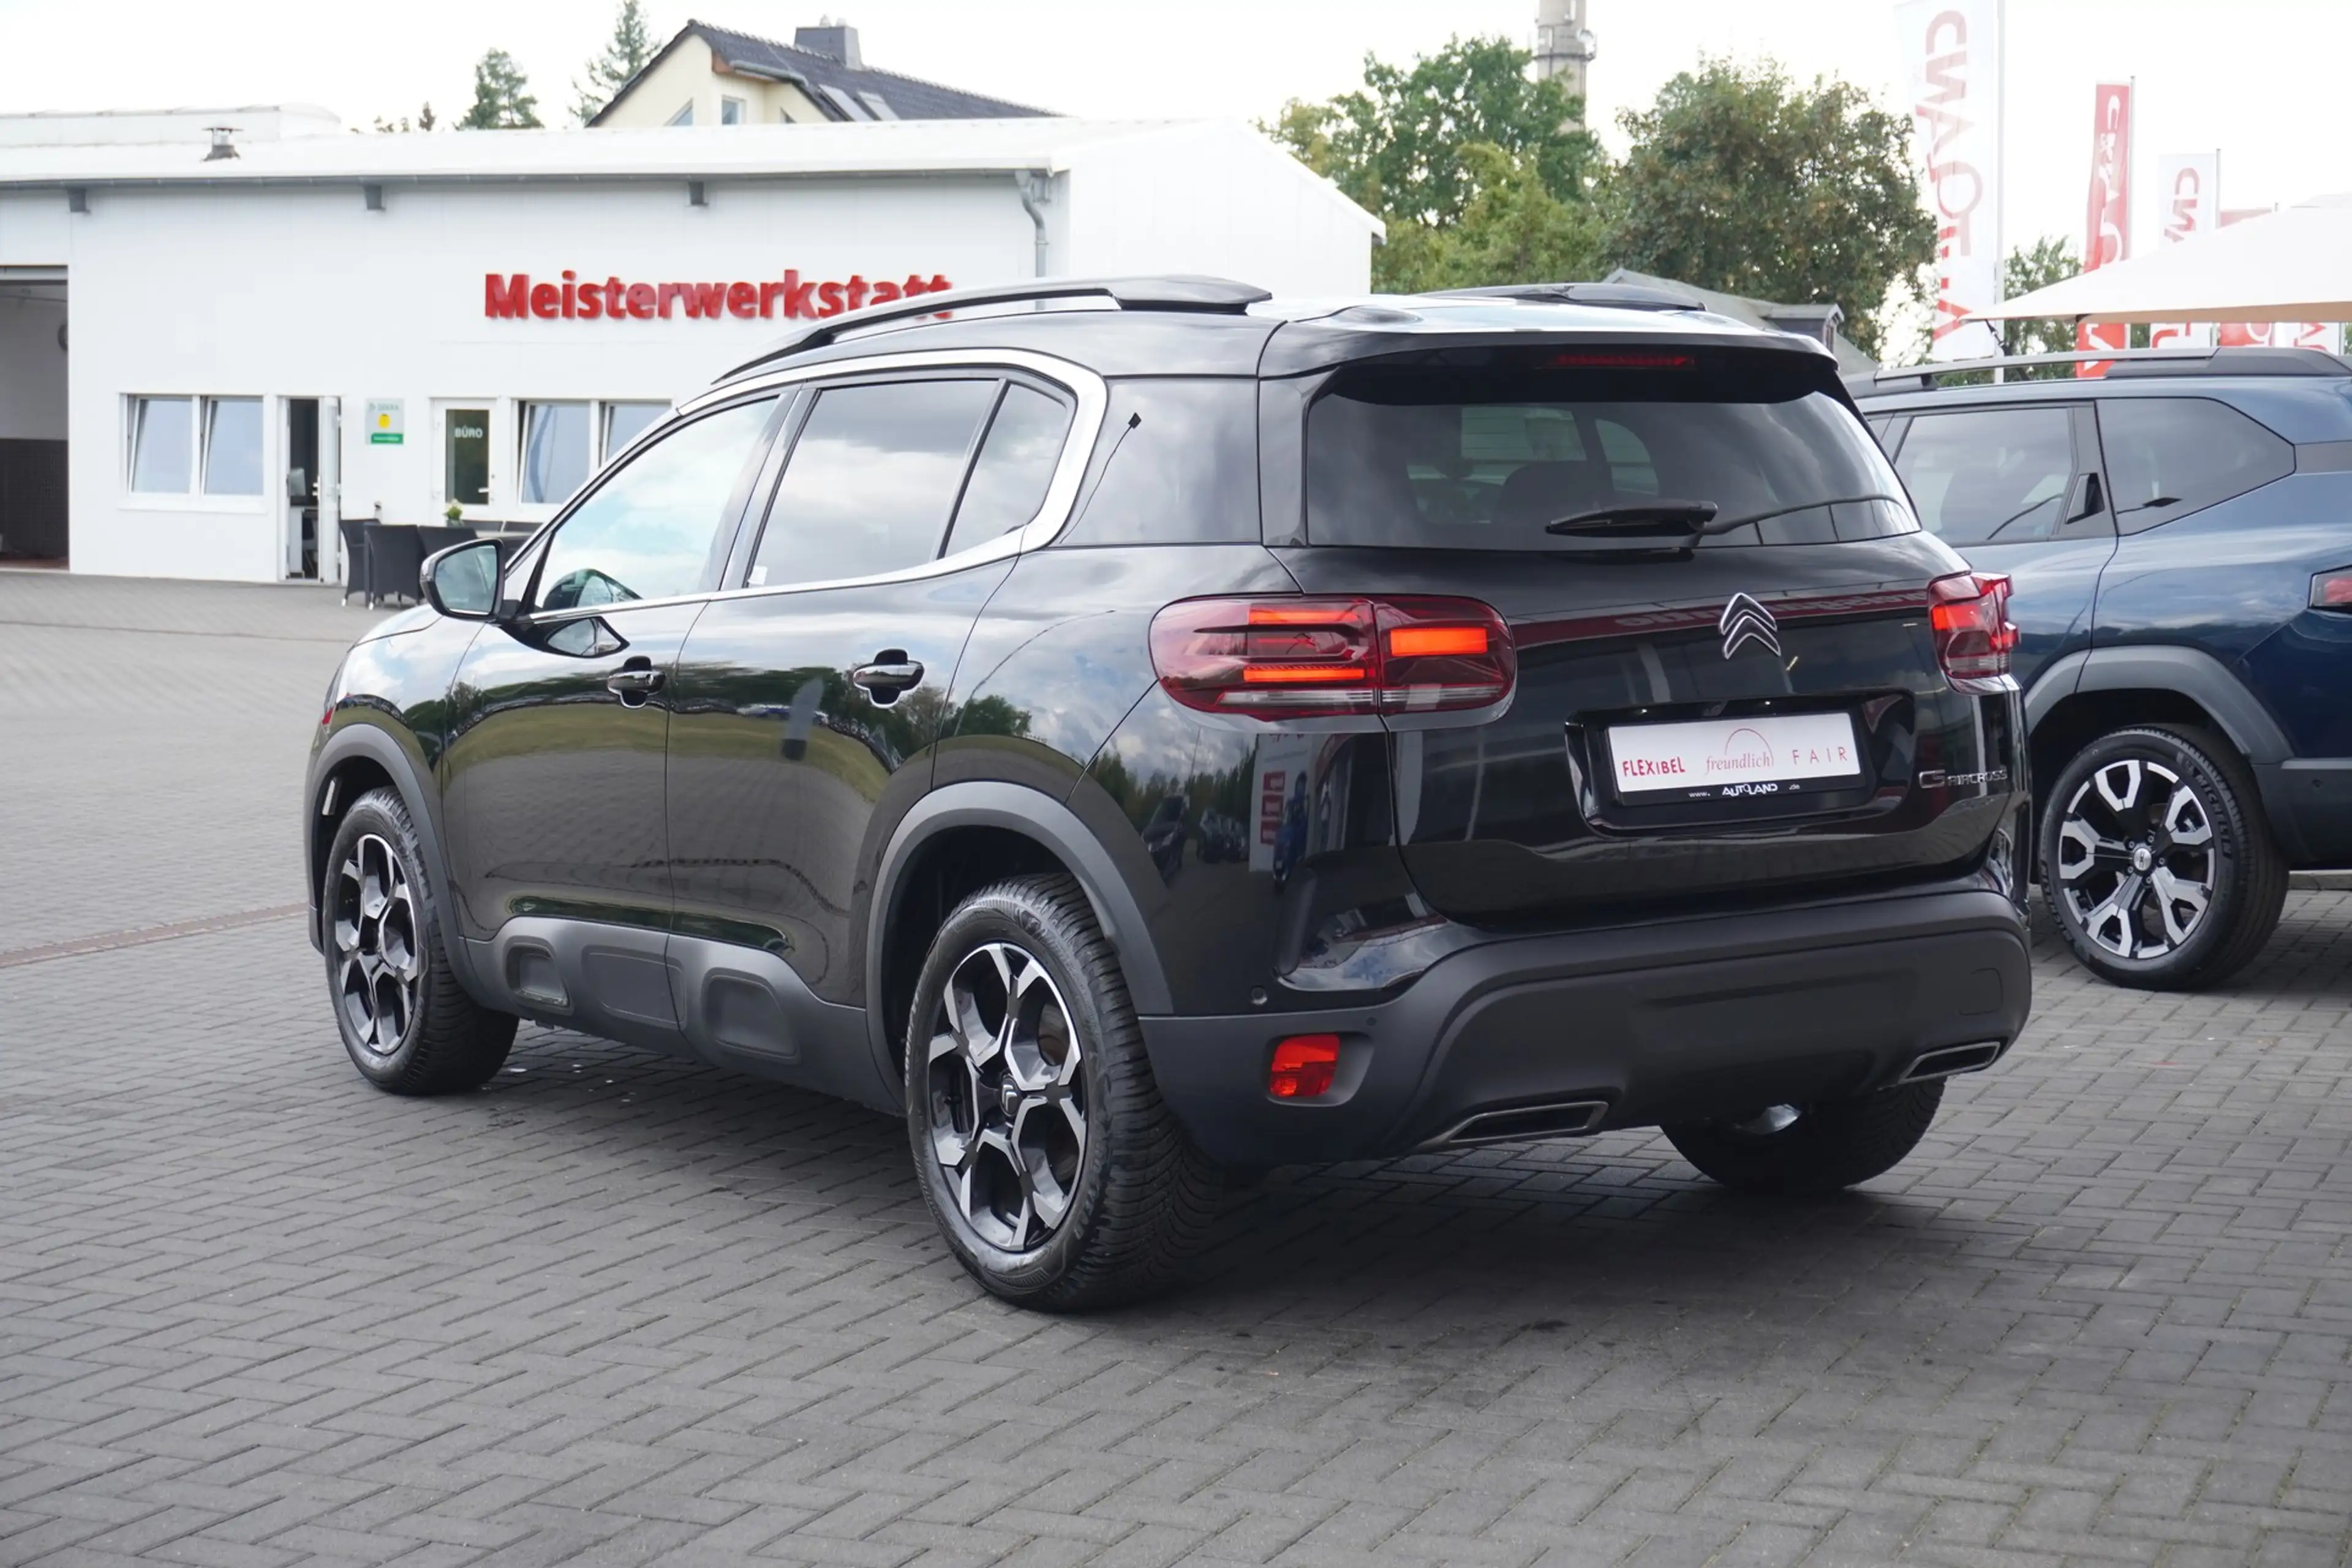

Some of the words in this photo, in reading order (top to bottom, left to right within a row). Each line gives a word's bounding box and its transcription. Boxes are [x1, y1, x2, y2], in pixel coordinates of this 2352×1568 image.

[454, 425, 483, 439] BÜRO
[1623, 756, 1686, 777] FLEXIBEL
[1705, 751, 1770, 774] freundlich
[1792, 746, 1847, 765] FAIR
[1919, 769, 1945, 788] C5
[1947, 769, 2008, 786] AIRCROSS
